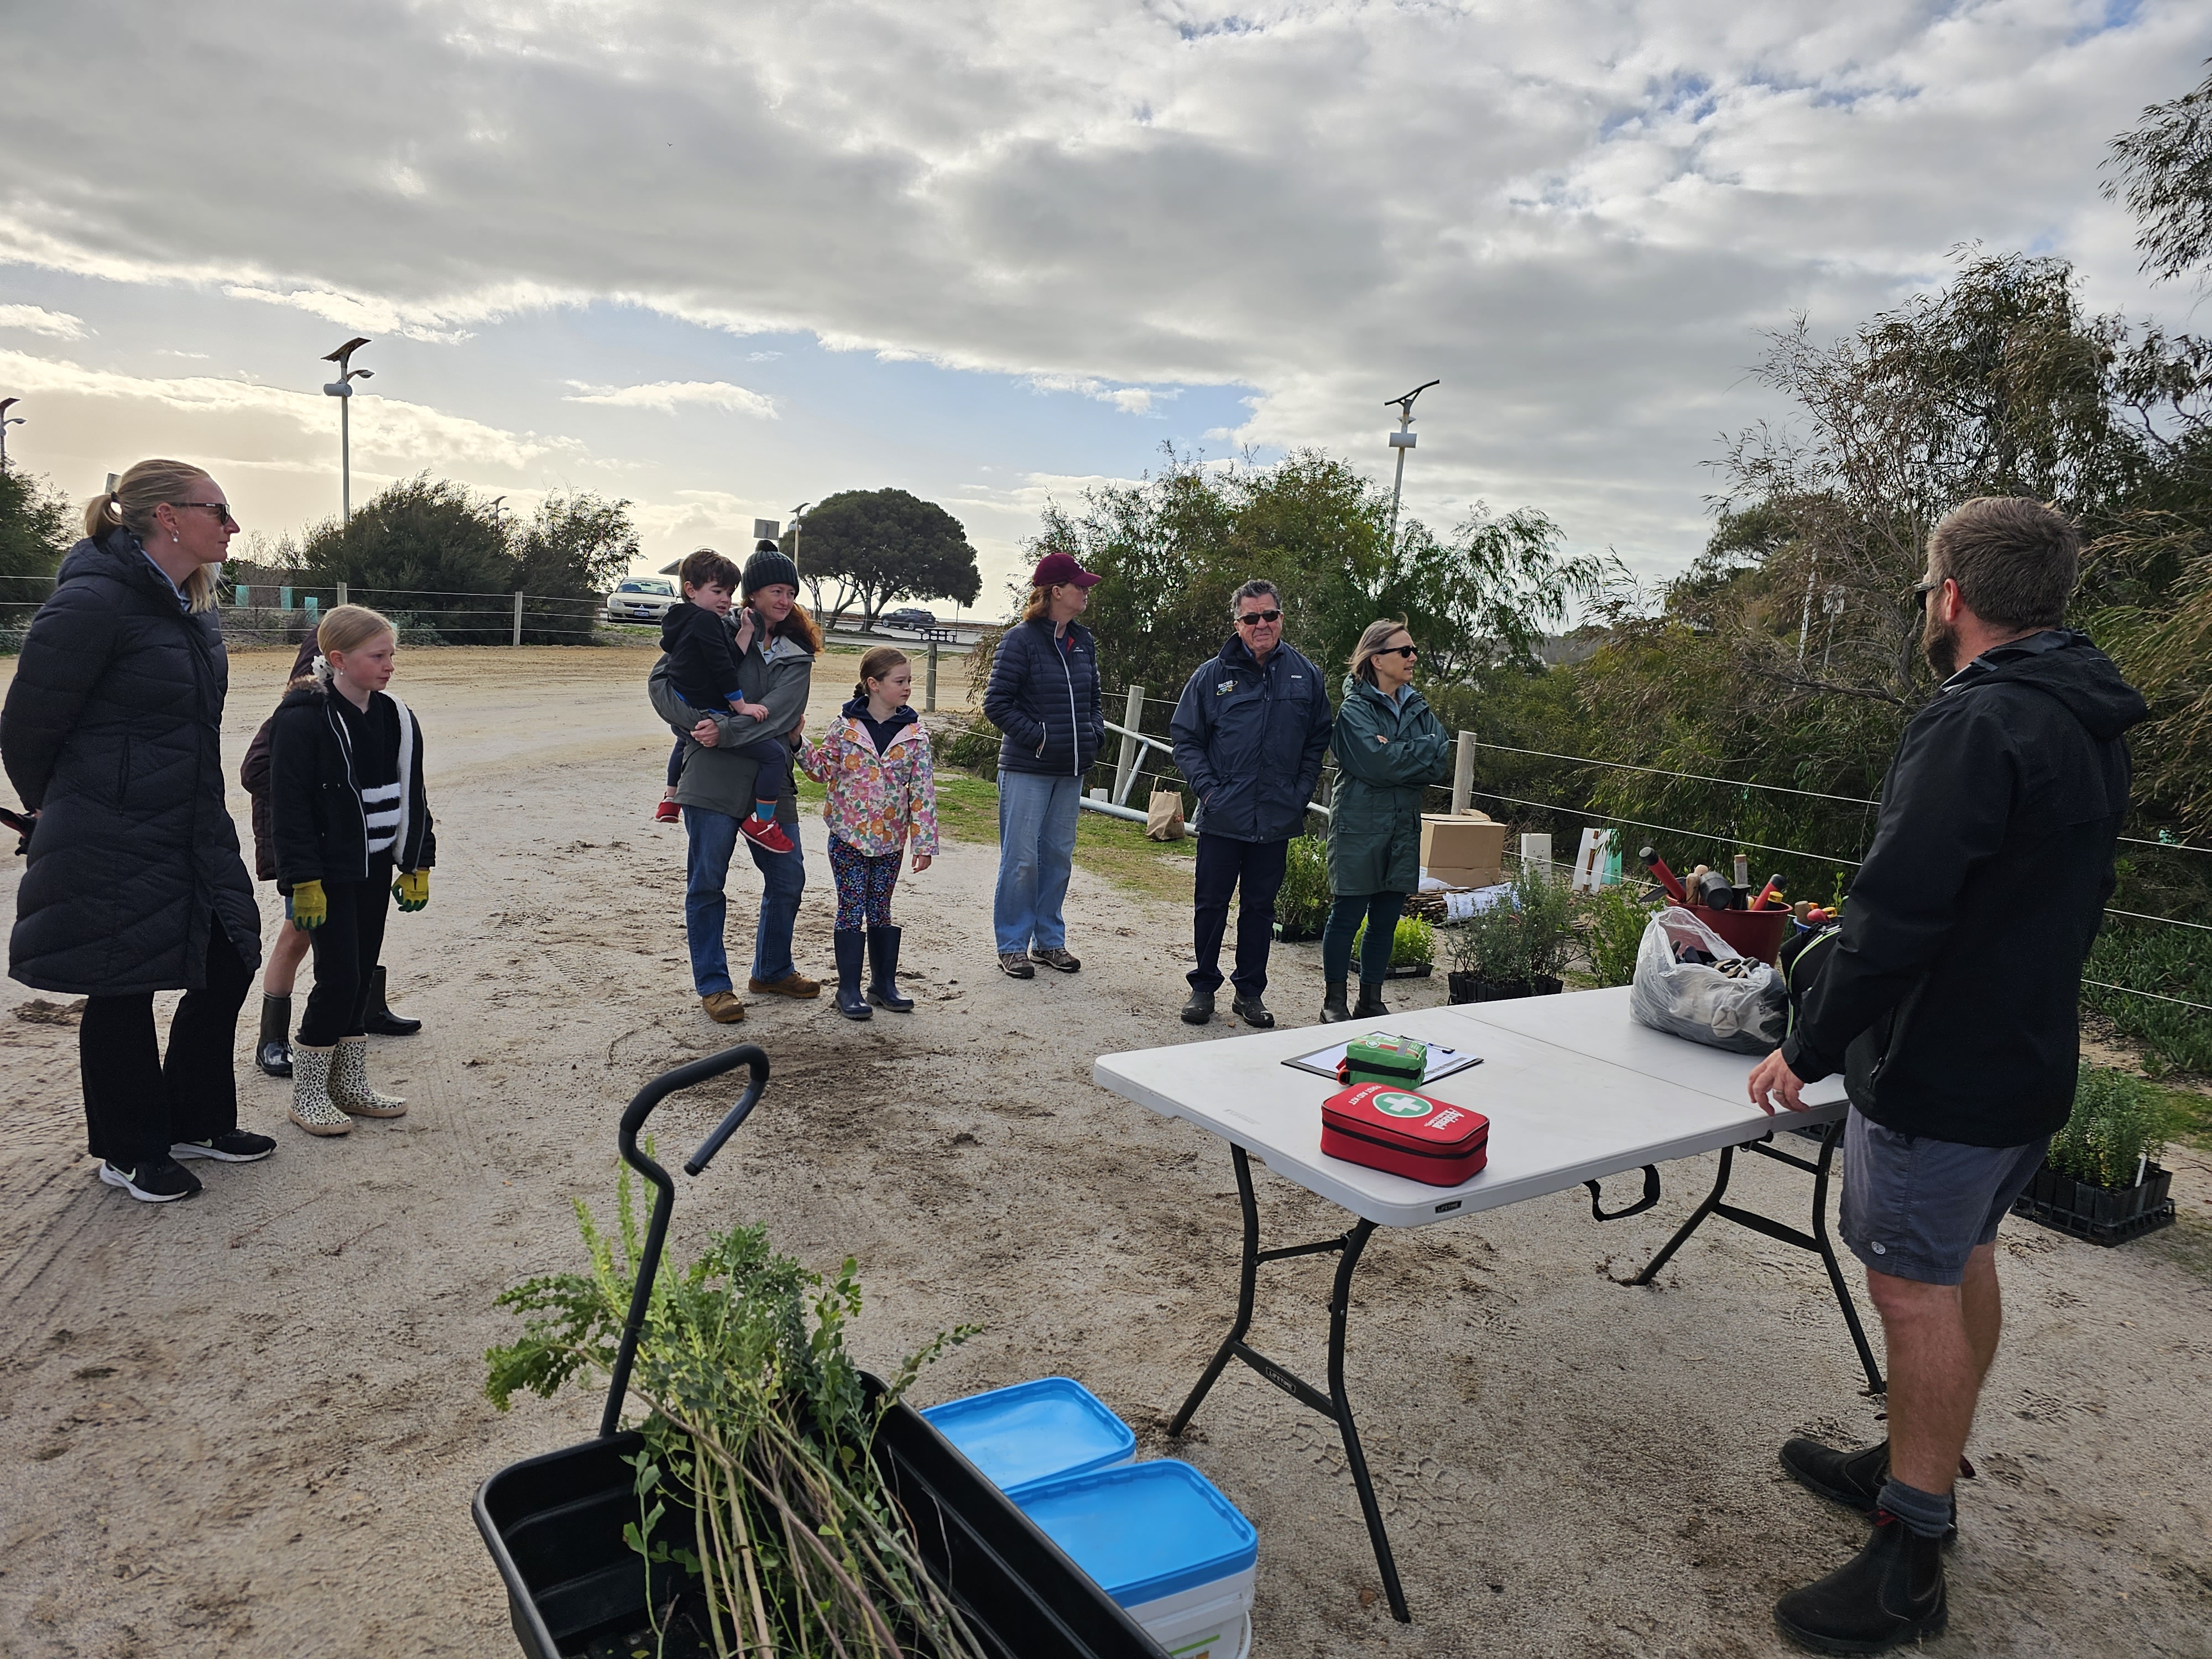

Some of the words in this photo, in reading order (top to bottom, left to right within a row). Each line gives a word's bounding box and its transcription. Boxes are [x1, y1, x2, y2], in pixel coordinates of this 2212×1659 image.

[1348, 1097, 1360, 1105] KIT
[1438, 1203, 1458, 1211] LIFETIME
[1269, 1370, 1292, 1390] LIFETIME
